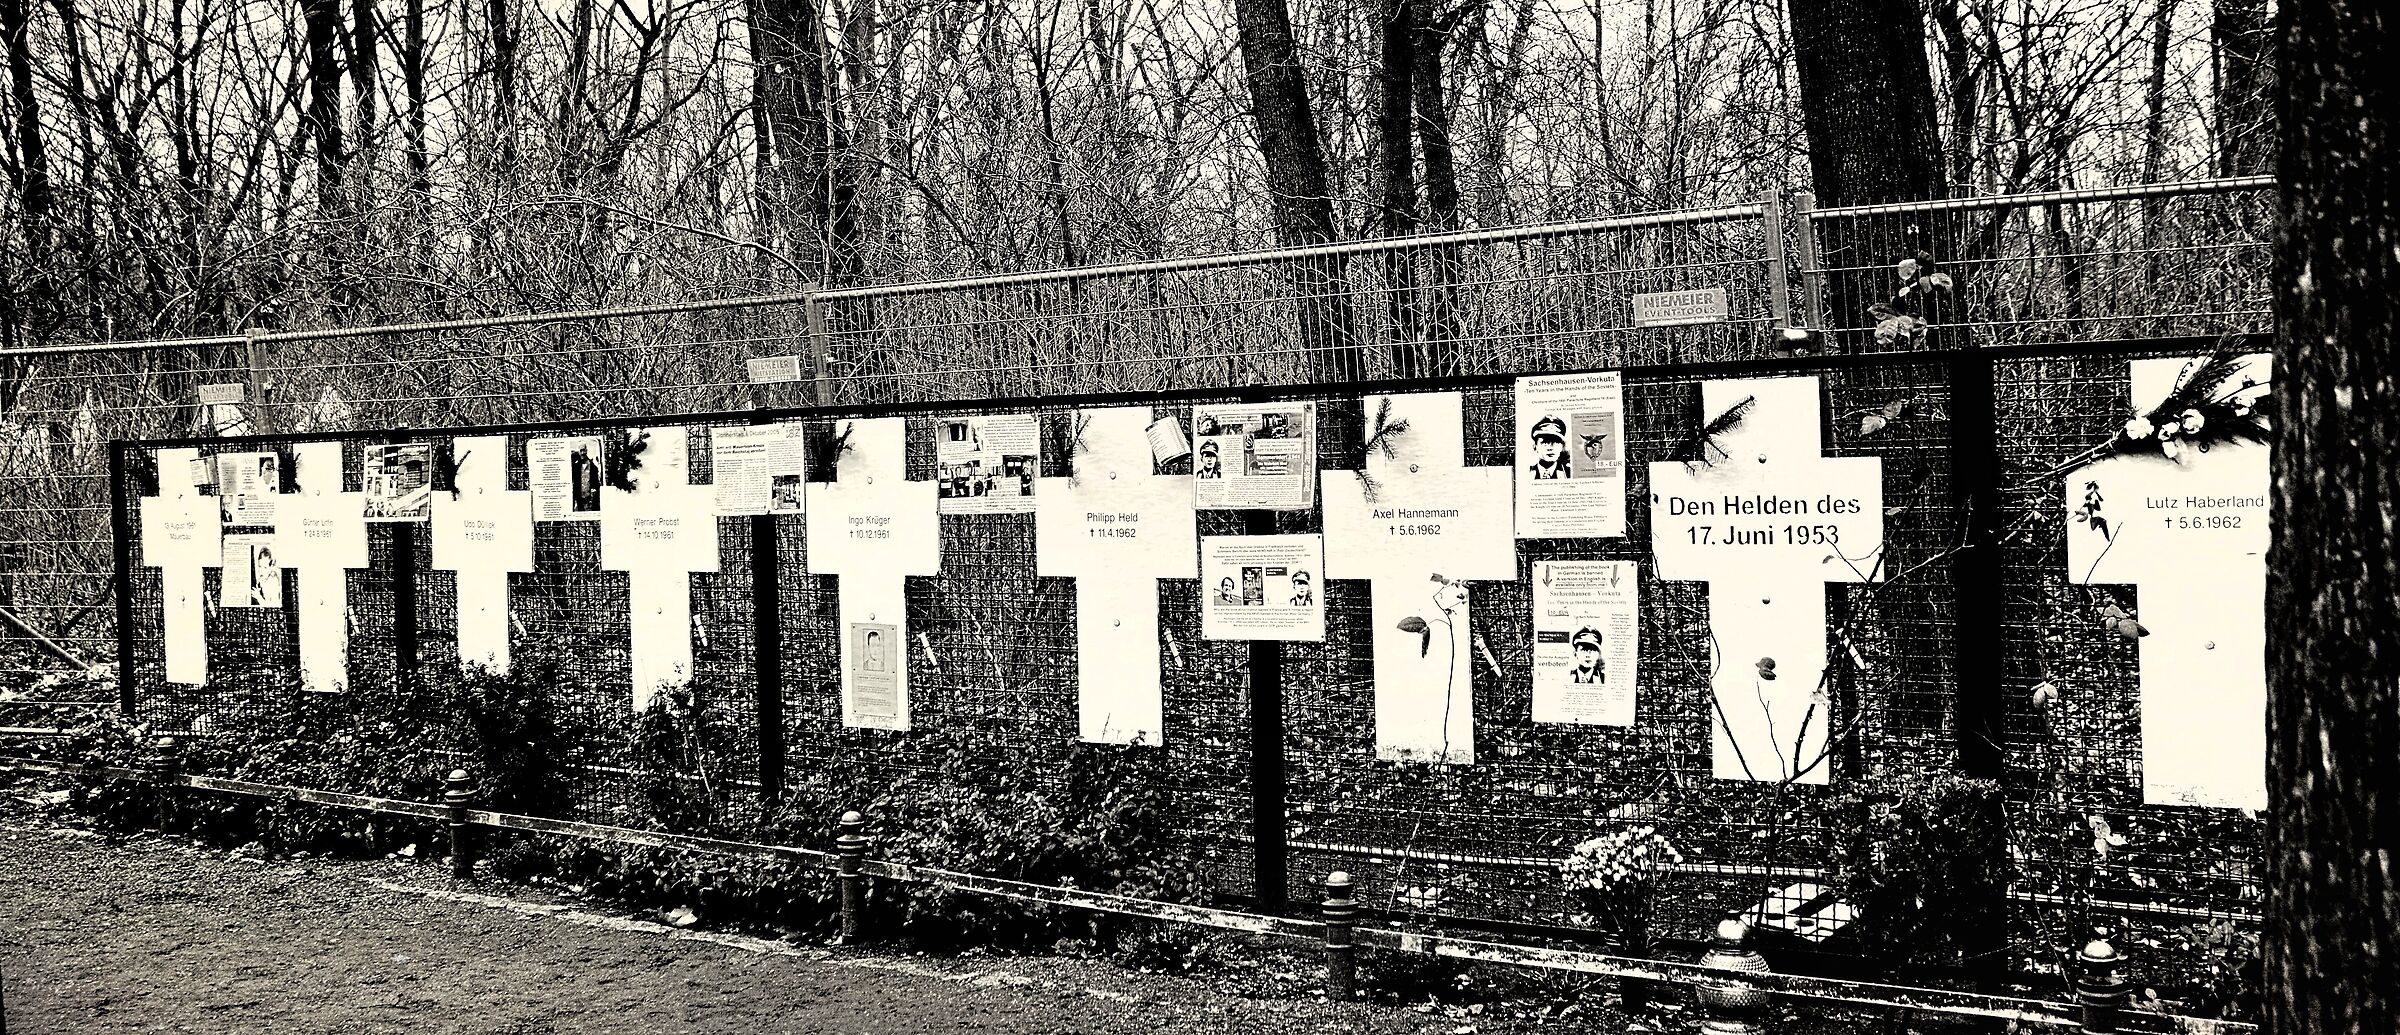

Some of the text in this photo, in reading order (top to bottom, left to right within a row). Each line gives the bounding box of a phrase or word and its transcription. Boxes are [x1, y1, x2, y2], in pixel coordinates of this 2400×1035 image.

[1643, 293, 1714, 308] NIEMEIER
[752, 360, 789, 370] NIEMEIER
[1529, 376, 1615, 387] Sachsenhausen-Vorkuta
[1670, 494, 1861, 515] Den Helden des
[2147, 496, 2264, 508] Lutz Haberland
[1087, 513, 1138, 524] Philipp Held
[1373, 509, 1459, 519] Axel Hannemann
[634, 517, 679, 526] Werner Probst
[849, 515, 890, 526] Ingo Krüger
[2179, 516, 2241, 529] 5.6.1962
[856, 529, 890, 539] 10.12.1961
[1098, 528, 1136, 538] 11.4.1962
[1399, 525, 1441, 535] 5.6.1962
[1687, 525, 1839, 545] 17. Juni 1953
